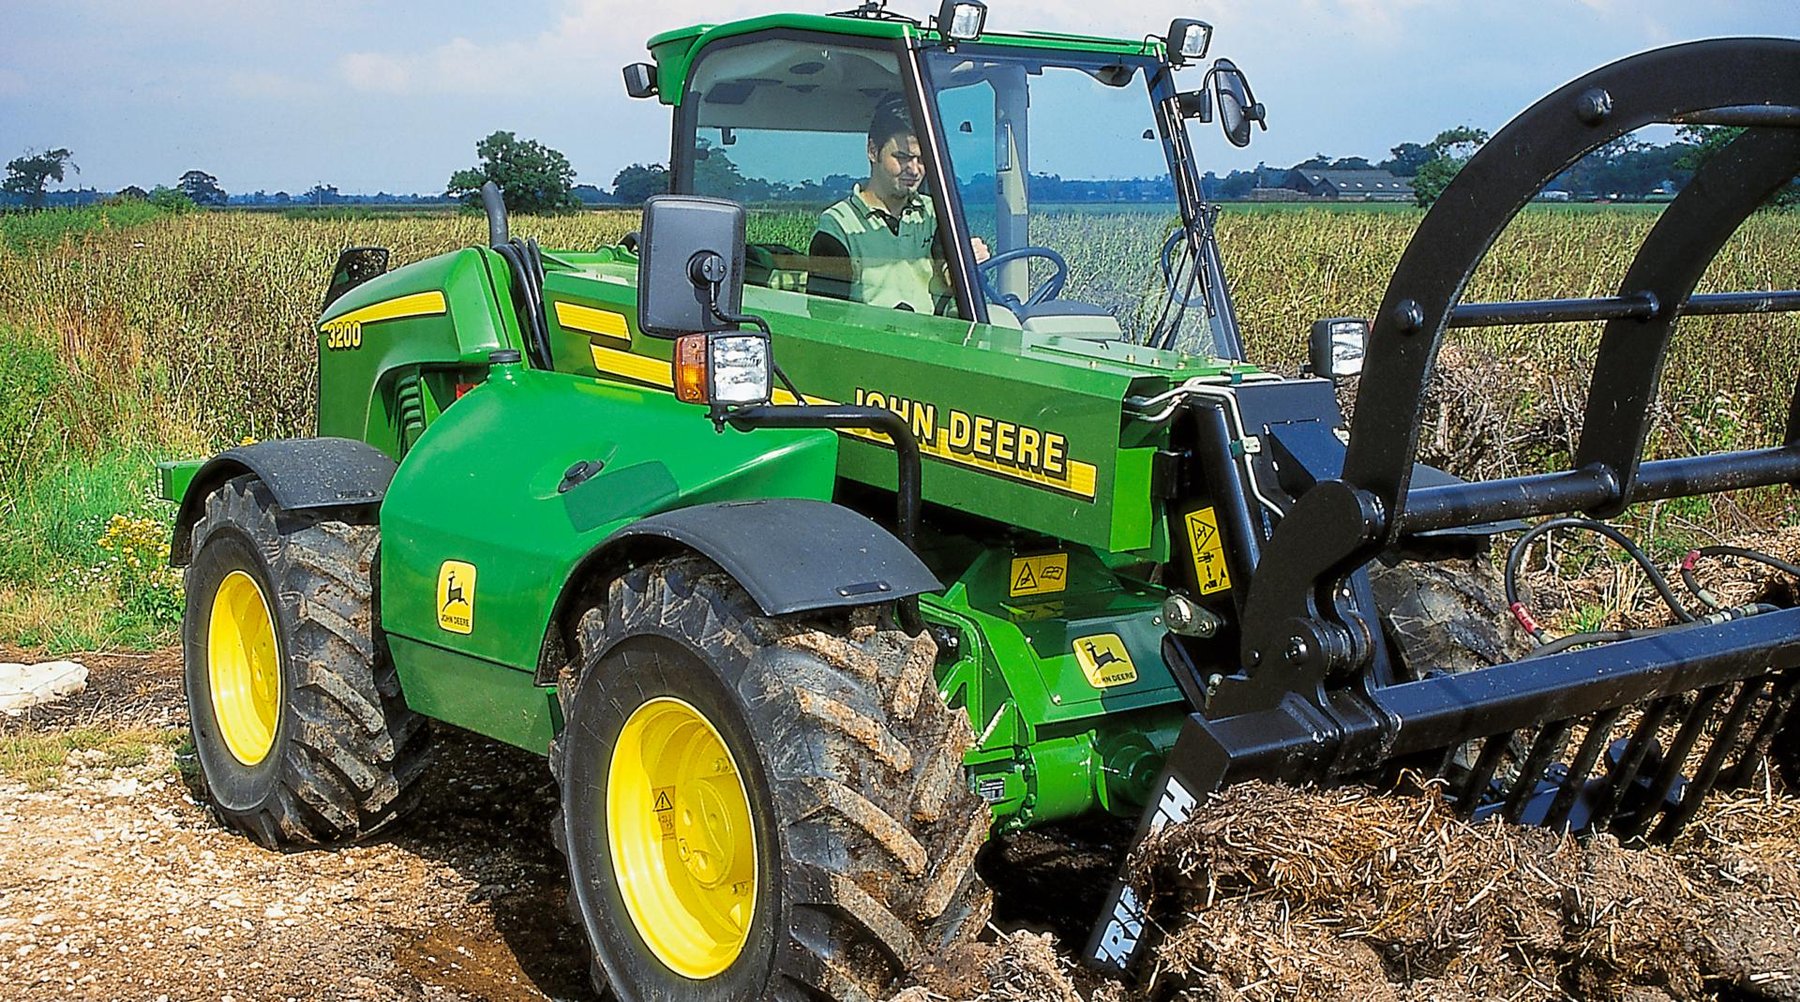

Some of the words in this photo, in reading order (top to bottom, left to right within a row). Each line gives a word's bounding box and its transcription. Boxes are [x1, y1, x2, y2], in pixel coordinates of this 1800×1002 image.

[327, 321, 362, 349] 3200
[949, 410, 1067, 478] DEERE
[1111, 671, 1136, 682] DEERE
